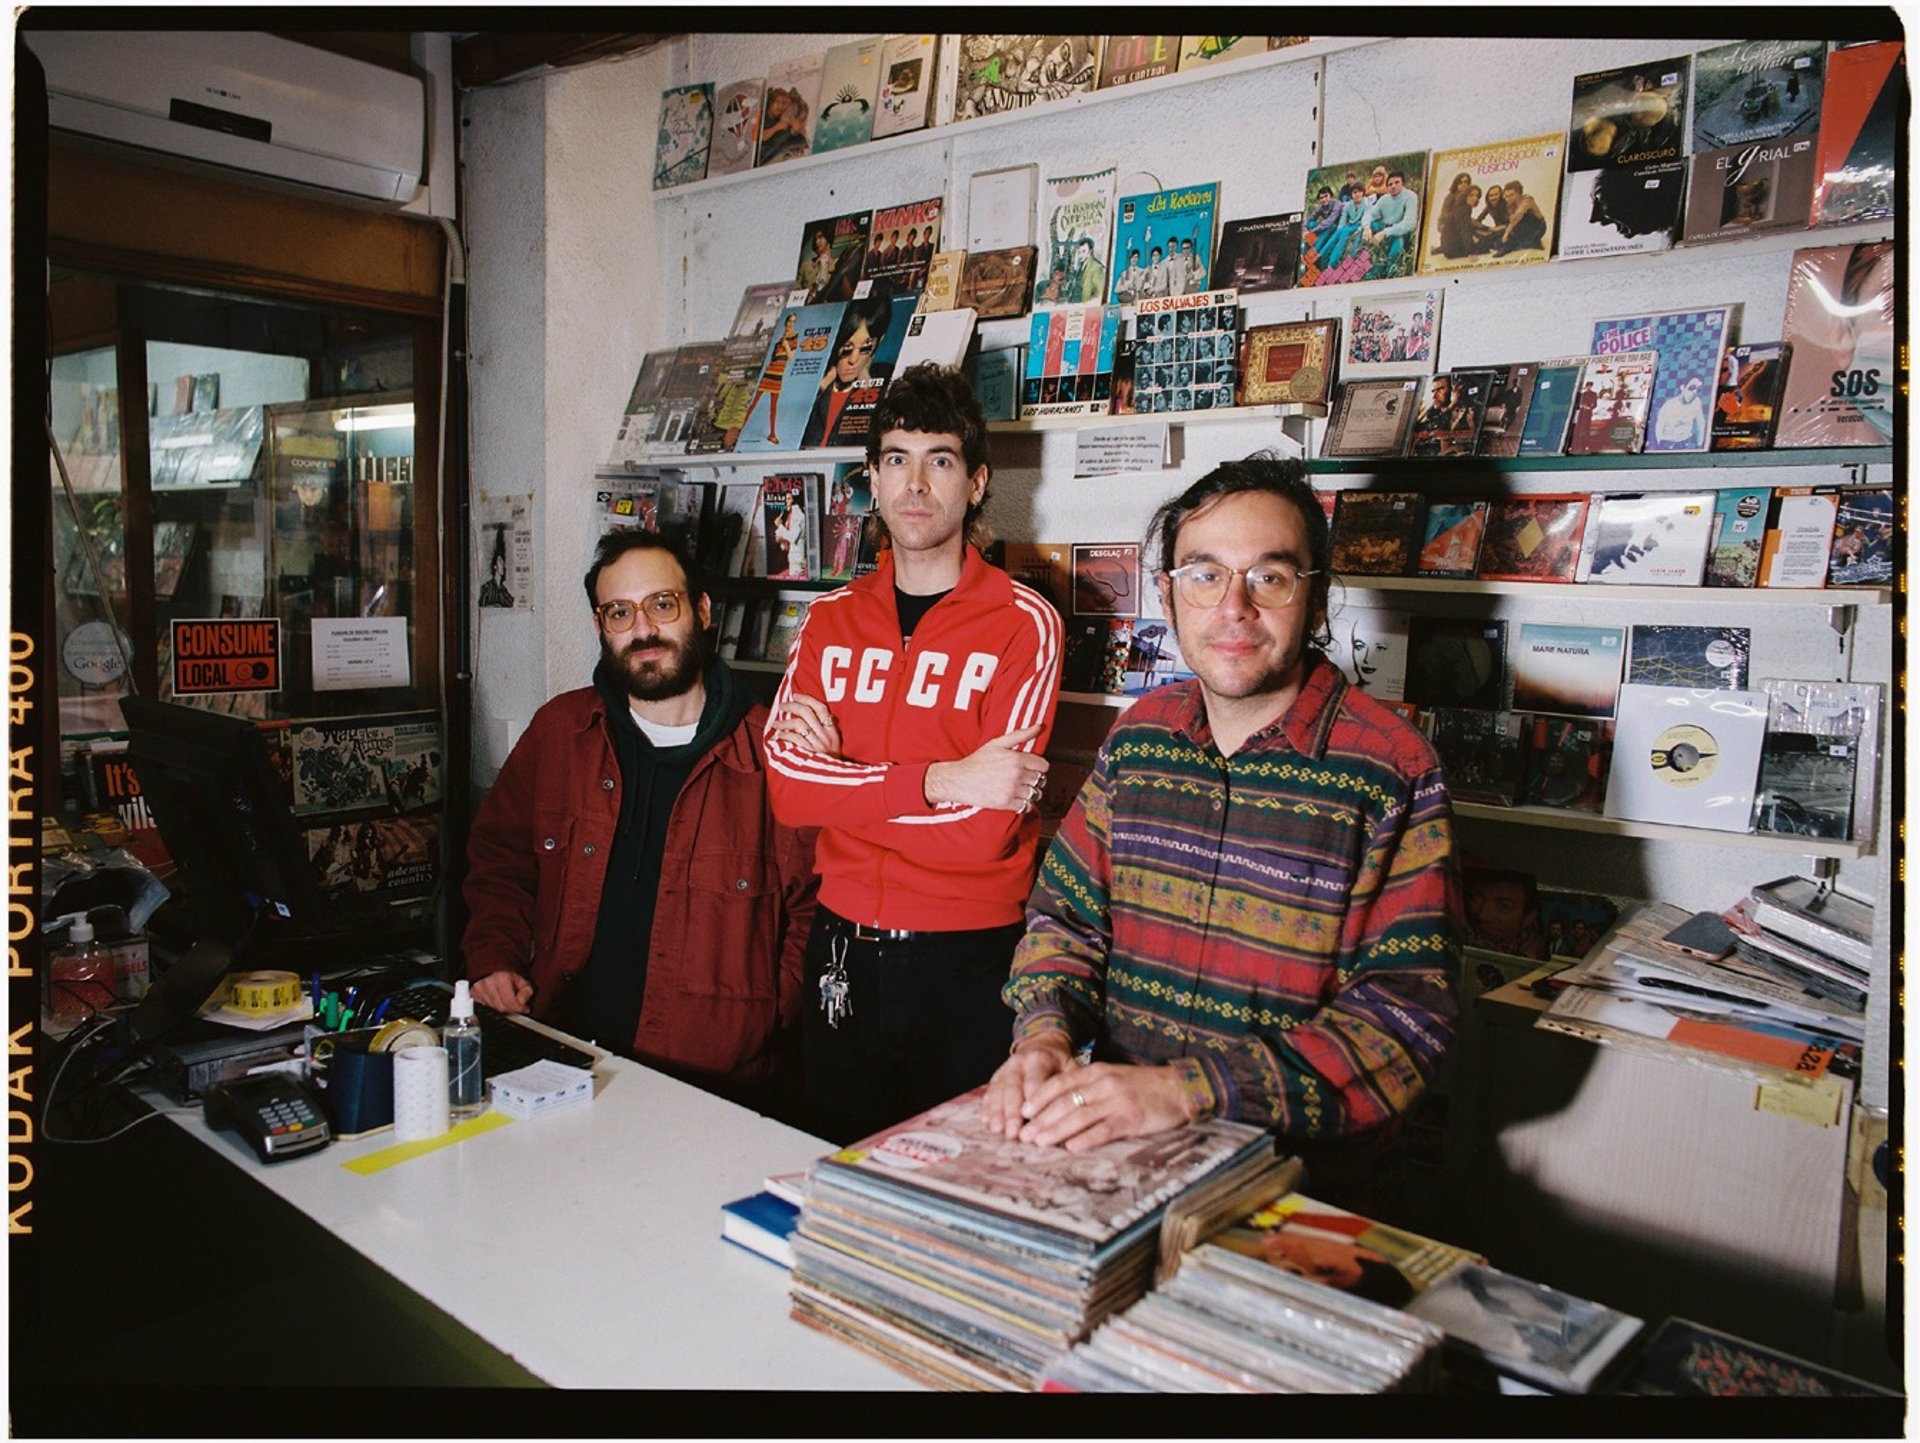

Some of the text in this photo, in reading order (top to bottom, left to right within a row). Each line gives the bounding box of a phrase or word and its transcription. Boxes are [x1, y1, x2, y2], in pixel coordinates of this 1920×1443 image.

[1617, 147, 1677, 165] CLAROSCURO
[1715, 156, 1732, 170] EL
[1146, 193, 1166, 213] Los
[873, 198, 942, 232] KINKS
[1139, 294, 1210, 314] LOS SALVAJES
[804, 326, 832, 337] CLUB
[1602, 327, 1620, 341] THE
[800, 335, 828, 353] 45
[1597, 328, 1651, 355] POLICE
[852, 377, 885, 389] CLUB
[1830, 368, 1881, 397] SOS
[845, 403, 877, 411] AGAIN
[1023, 405, 1036, 416] LOS
[763, 476, 804, 493] Elvis
[176, 623, 276, 657] CONSUME
[73, 656, 122, 673] Google
[182, 662, 231, 688] LOCAL
[820, 645, 999, 711] CCCP
[104, 762, 142, 798] It's
